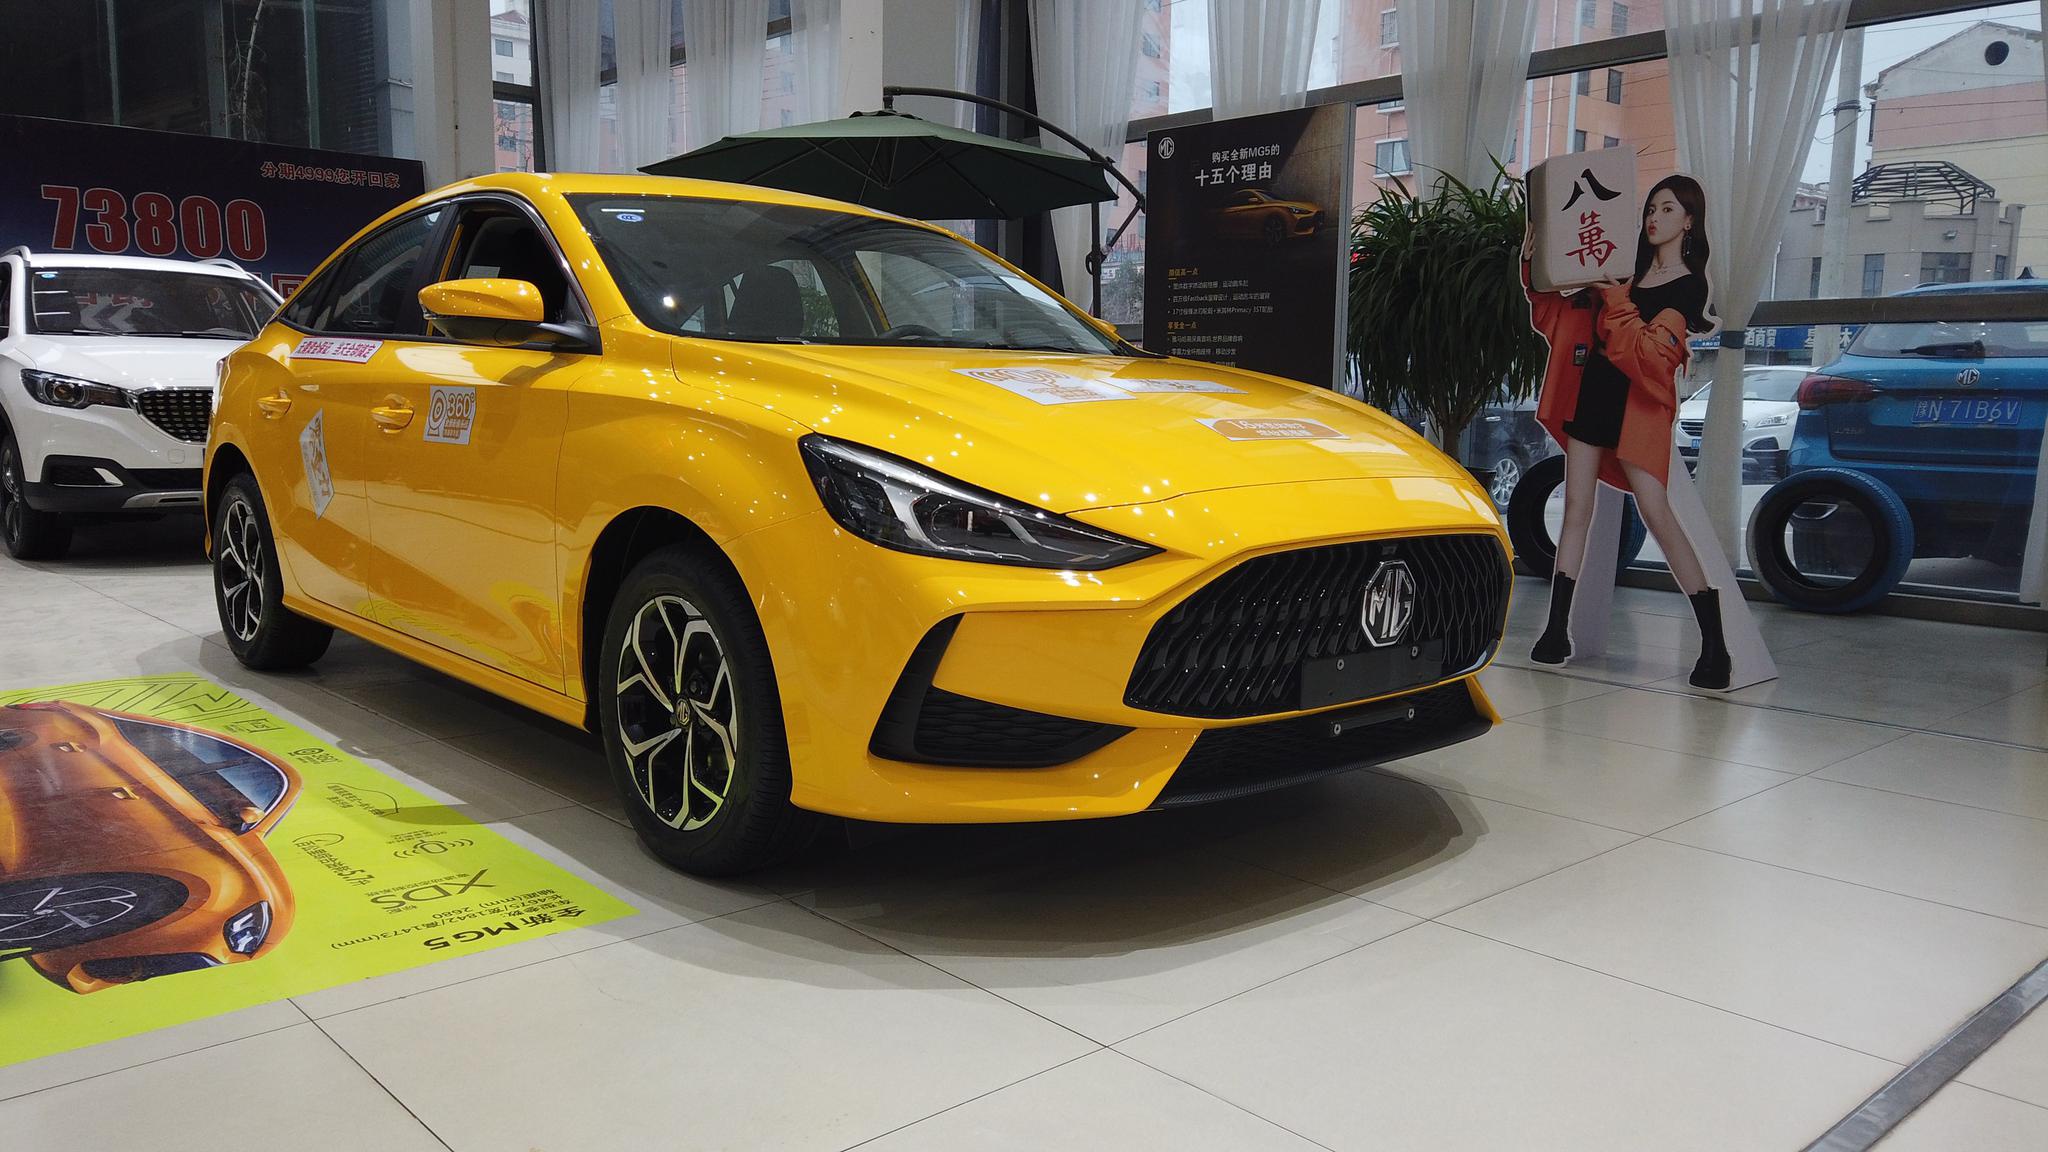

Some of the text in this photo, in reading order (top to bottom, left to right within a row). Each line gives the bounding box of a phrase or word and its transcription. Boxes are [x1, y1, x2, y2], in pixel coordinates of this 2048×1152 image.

[1160, 138, 1174, 158] MG
[1211, 144, 1280, 164] 购买全新MG5的
[260, 161, 401, 188] 分期4999您开回家
[1194, 161, 1272, 187] 十五个理由
[40, 184, 267, 262] 73800
[1957, 368, 1979, 385] MG
[1368, 568, 1413, 639] MG
[370, 868, 496, 911] XDS
[431, 906, 471, 919] 2680
